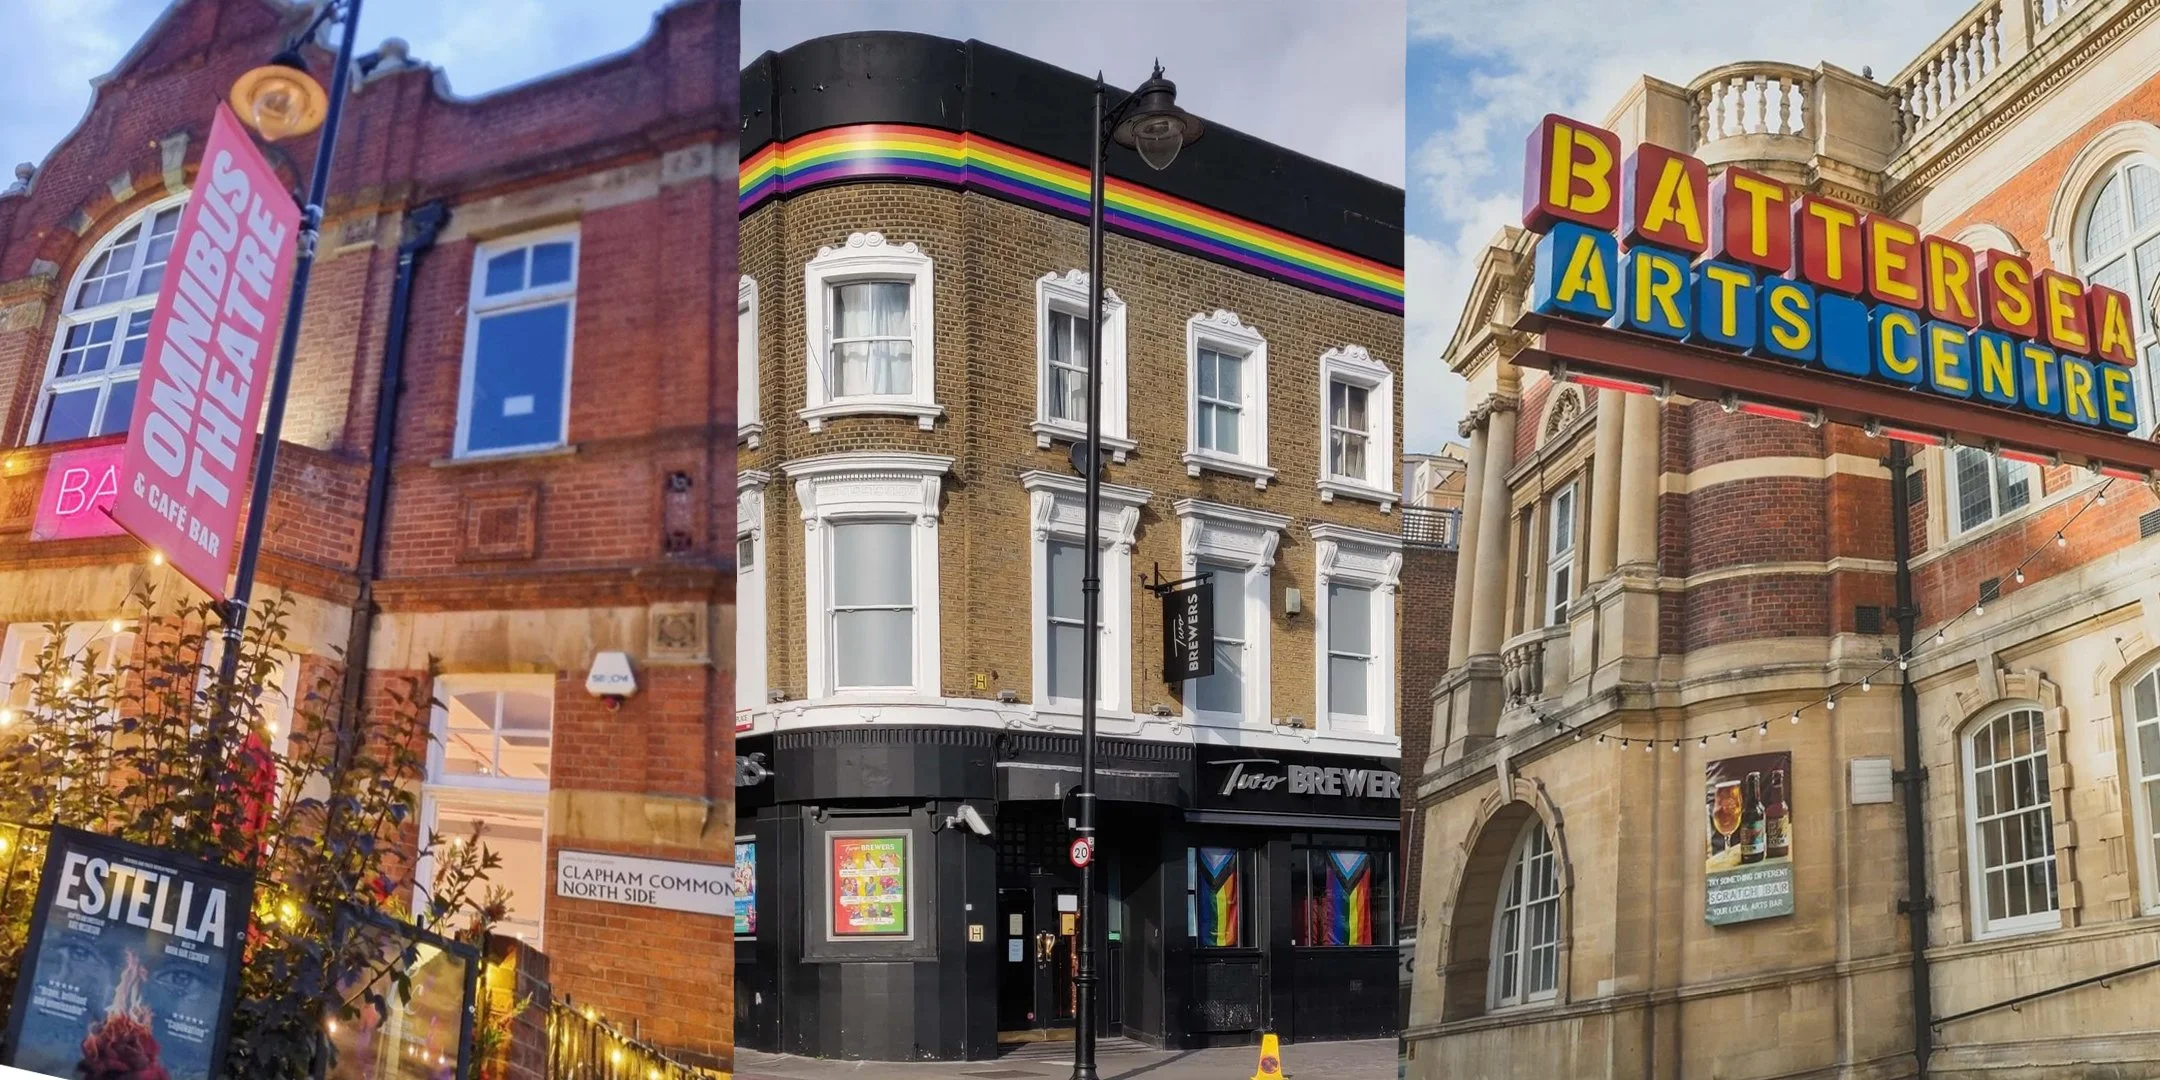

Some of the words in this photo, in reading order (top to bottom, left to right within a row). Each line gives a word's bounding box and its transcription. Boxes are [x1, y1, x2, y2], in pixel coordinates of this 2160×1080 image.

[1550, 124, 2136, 360] BATTERSEA
[143, 150, 252, 478] OMNIBUS
[1556, 236, 1811, 352] ARTS
[1881, 313, 2135, 425] CENTRE
[186, 192, 287, 508] THEATRE
[134, 472, 145, 497] &
[148, 483, 188, 532] CAFÉ
[188, 516, 220, 558] BAR
[1173, 614, 1187, 658] Two
[1187, 593, 1199, 671] BREWERS
[976, 674, 986, 688] H
[1207, 759, 1287, 796] Two
[1287, 765, 1400, 798] BREWER
[1074, 847, 1088, 859] 20
[563, 865, 643, 887] CLAPHAM
[649, 874, 735, 896] COMMON
[563, 881, 619, 900] NORTH
[624, 887, 656, 904] SIDE
[1709, 887, 1757, 903] SCRATCH
[1765, 882, 1788, 896] BAR
[1720, 872, 1753, 885] SOMETHING
[1754, 868, 1788, 880] DIFFERENT
[55, 851, 227, 948] ESTELLA
[1713, 907, 1728, 916] YOUR
[1729, 904, 1749, 913] LOCAL
[1751, 901, 1768, 910] ARTS
[1769, 898, 1783, 908] BAR
